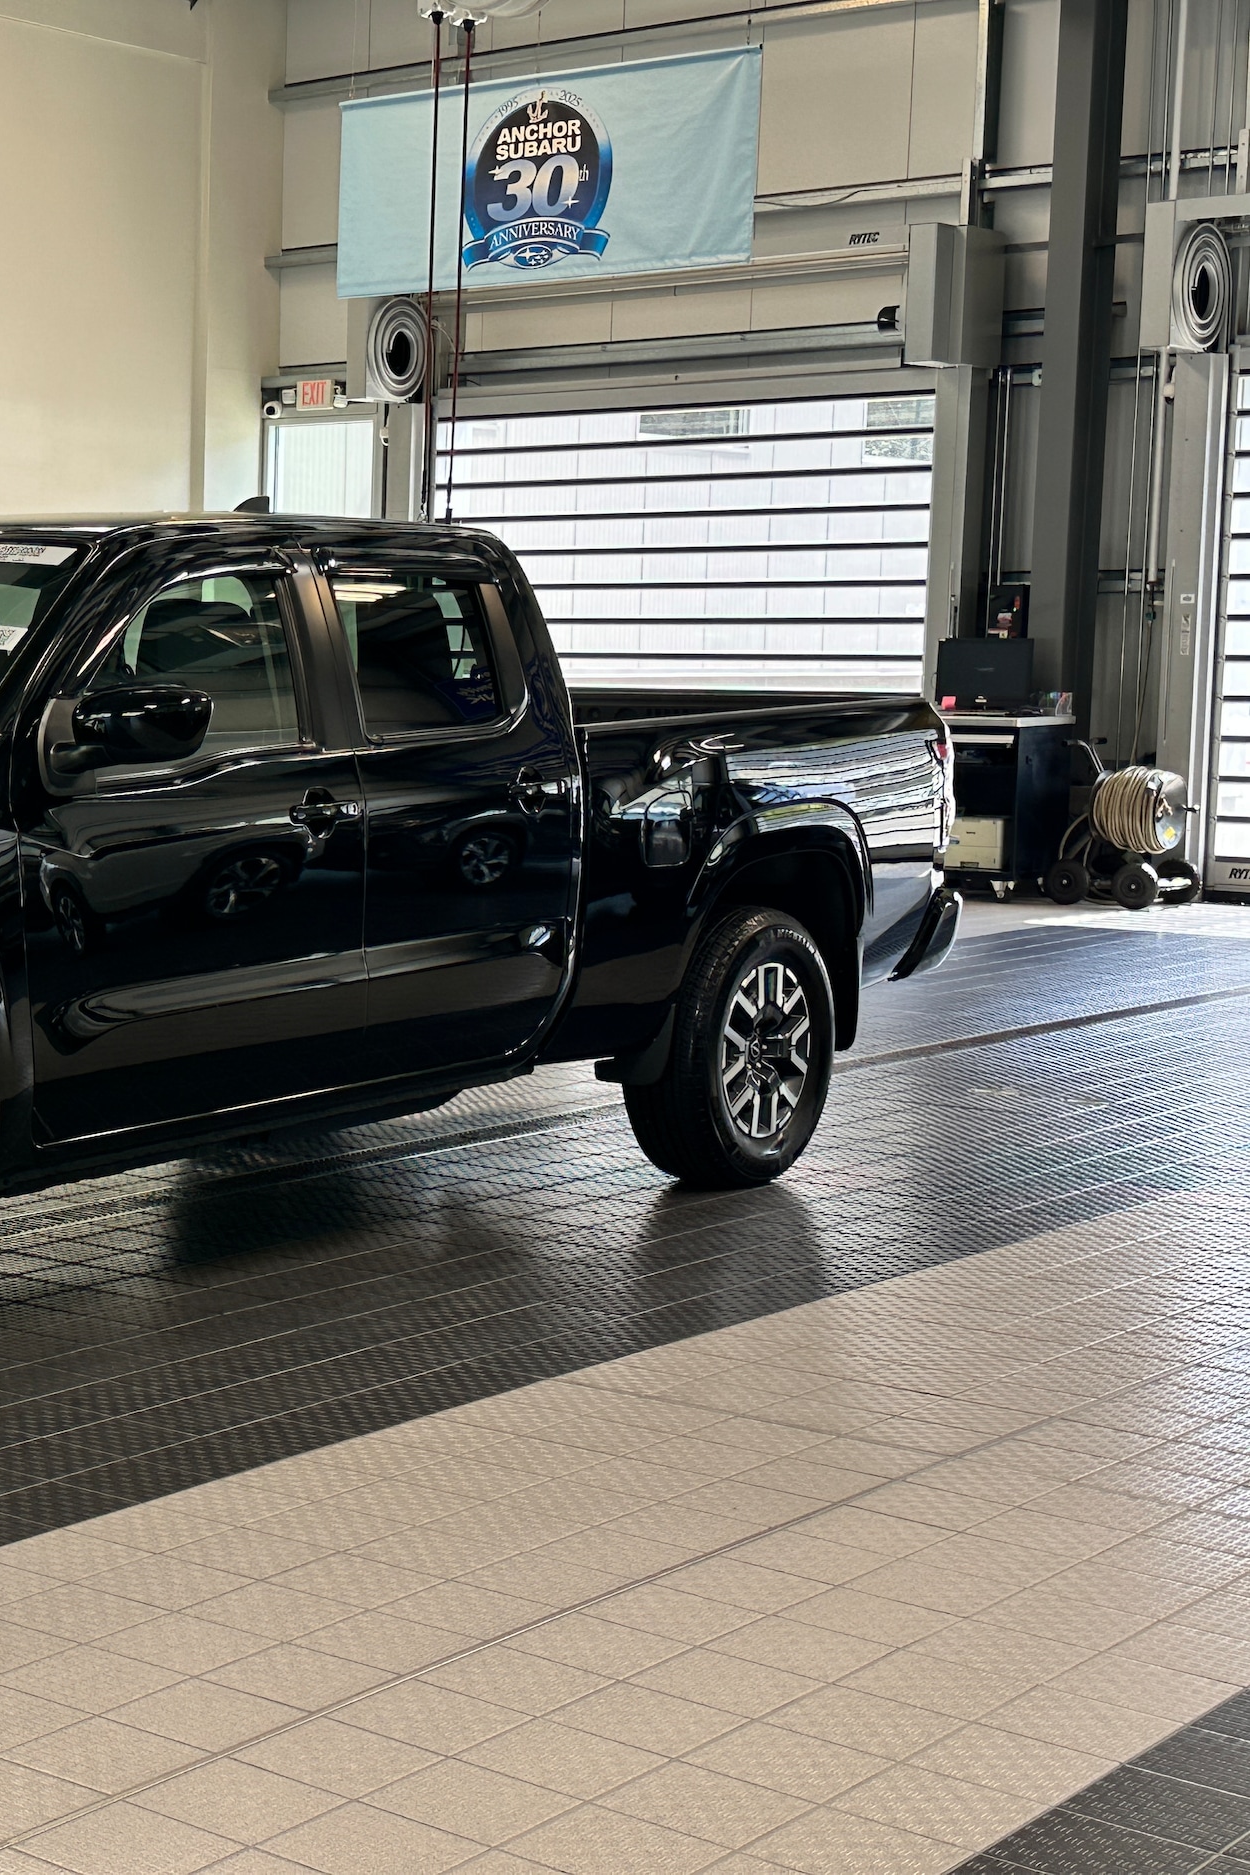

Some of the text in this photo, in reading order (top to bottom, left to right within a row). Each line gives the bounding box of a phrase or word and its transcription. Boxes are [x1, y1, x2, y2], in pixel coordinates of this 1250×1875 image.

[497, 89, 582, 118] 1995 2025
[496, 119, 582, 145] ANCHOR
[495, 135, 582, 161] SUBARU
[489, 221, 581, 251] ANNIVERSARY
[301, 381, 327, 407] EXIT
[1228, 867, 1250, 880] RYT
